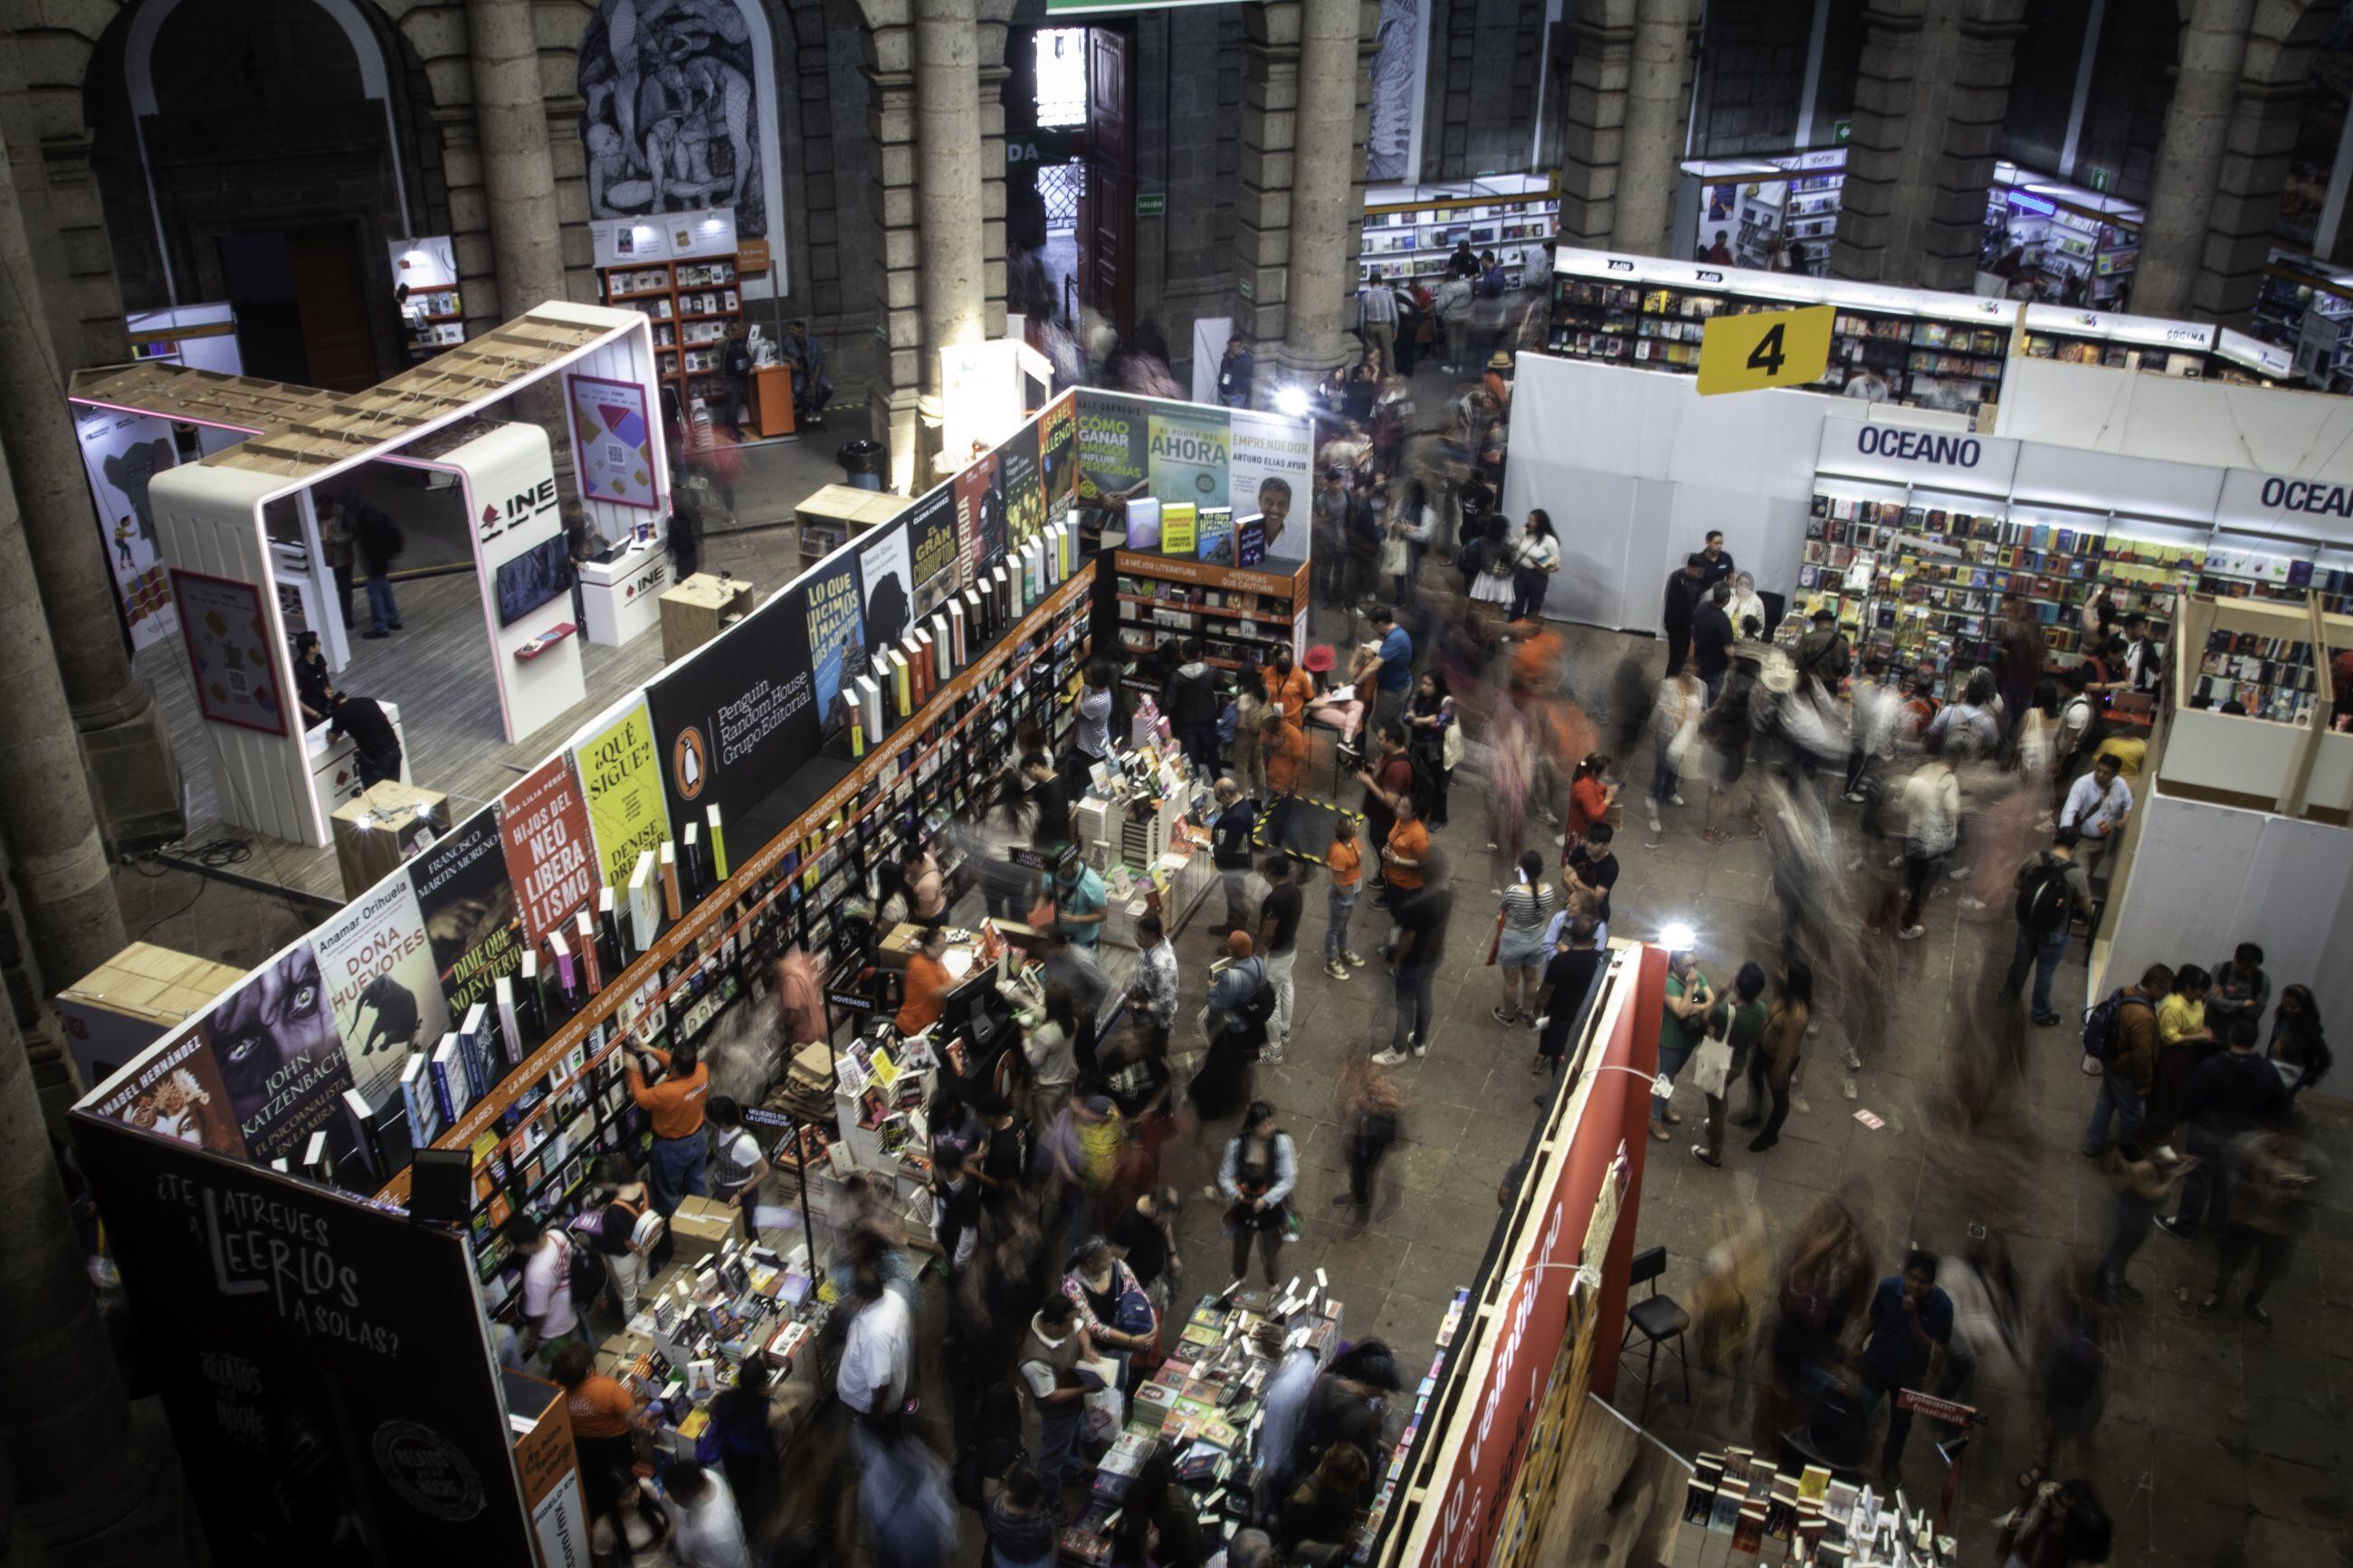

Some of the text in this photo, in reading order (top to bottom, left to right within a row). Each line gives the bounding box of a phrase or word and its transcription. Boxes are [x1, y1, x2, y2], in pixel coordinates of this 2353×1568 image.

[1138, 201, 1163, 209] SALIDA
[1612, 260, 1630, 271] AdN
[1700, 272, 1719, 282] AdN
[1746, 323, 1786, 375] 4
[2167, 329, 2205, 344] COCINA
[1041, 418, 1077, 457] ALLENDE
[1043, 401, 1072, 433] ISABEL
[1078, 415, 1129, 434] CÓMO
[1078, 430, 1129, 447] GANAR
[1172, 429, 1199, 440] PODER
[1150, 435, 1227, 464] AHORA
[1232, 434, 1310, 454] EMPRENDEDOR
[1232, 453, 1262, 465] ARTURO
[1286, 460, 1307, 471] AYUB
[1857, 426, 1980, 469] OCEANO
[1079, 461, 1141, 479] PERSONAS
[506, 478, 556, 519] INE
[913, 509, 930, 525] ELENA
[2262, 477, 2353, 518] OCEA
[914, 537, 956, 586] CORRUPTOR
[915, 524, 951, 561] GRAN
[957, 495, 974, 593] IZQUIERDA
[637, 565, 665, 593] INE
[807, 572, 852, 607] LO QUE
[1120, 557, 1197, 577] LA MEJOR LITERATURA
[1222, 578, 1275, 594] QUE CAUTIVAN
[1228, 571, 1268, 584] HISTORIAS
[806, 589, 859, 650] HICIMOS
[812, 611, 859, 671] LOS ADULTOS
[819, 613, 842, 641] MAL
[718, 679, 770, 727] Penguin
[719, 671, 808, 746] Random House
[1120, 678, 1161, 693] PRESENTACIONES
[595, 722, 637, 771] ¿QUÉ
[722, 684, 813, 765] Grupo Editorial
[589, 741, 651, 801] SIGUE?
[862, 727, 917, 779] CONTEMPORÁNEA
[505, 769, 568, 821] ANA LILIA PÉREZ
[512, 790, 572, 847] HIJOS DEL
[804, 777, 859, 828] PREMIOS NOBEL
[427, 830, 481, 875] FRANCISCO
[455, 836, 498, 871] MORENO
[529, 818, 568, 865] NEO
[612, 819, 658, 866] DENISE
[737, 827, 801, 889] CONTEMPORÁNEA
[524, 840, 586, 905] LIBERA
[319, 918, 361, 955] Anamar
[362, 879, 407, 920] Orihuela
[531, 867, 590, 933] LISMO
[670, 889, 732, 949] TEMAS PARA DEBATIR
[331, 927, 426, 1012] HUEVOTES
[346, 926, 400, 976] DOÑA
[452, 925, 512, 985] DIME QUE
[450, 943, 524, 1017] NO ES CIERTO
[593, 952, 662, 1019] LA MEJOR LITERATURA
[831, 994, 871, 1009] NOVEDADES
[96, 1034, 203, 1117] ANABEL HERNÁNDEZ
[265, 1049, 312, 1097] JOHN
[508, 1022, 585, 1095] LA MEJOR LITERATURA
[241, 1046, 348, 1139] KATZENBACH
[748, 1107, 777, 1119] MUJERES
[254, 1077, 349, 1158] EL PSICOANALISTA
[275, 1104, 337, 1156] EN LA MIRA
[447, 1104, 495, 1151] SINGULARES
[157, 1174, 198, 1207] ¿TE
[224, 1189, 329, 1248] ATREVES
[202, 1186, 360, 1317] LEERLOS
[294, 1298, 400, 1358] A SOLAS?
[1469, 1202, 1563, 1476] veintiuno
[1906, 1393, 1957, 1412] galeano
[1912, 1403, 1965, 1425] foucault
[562, 1475, 576, 1491] EN
